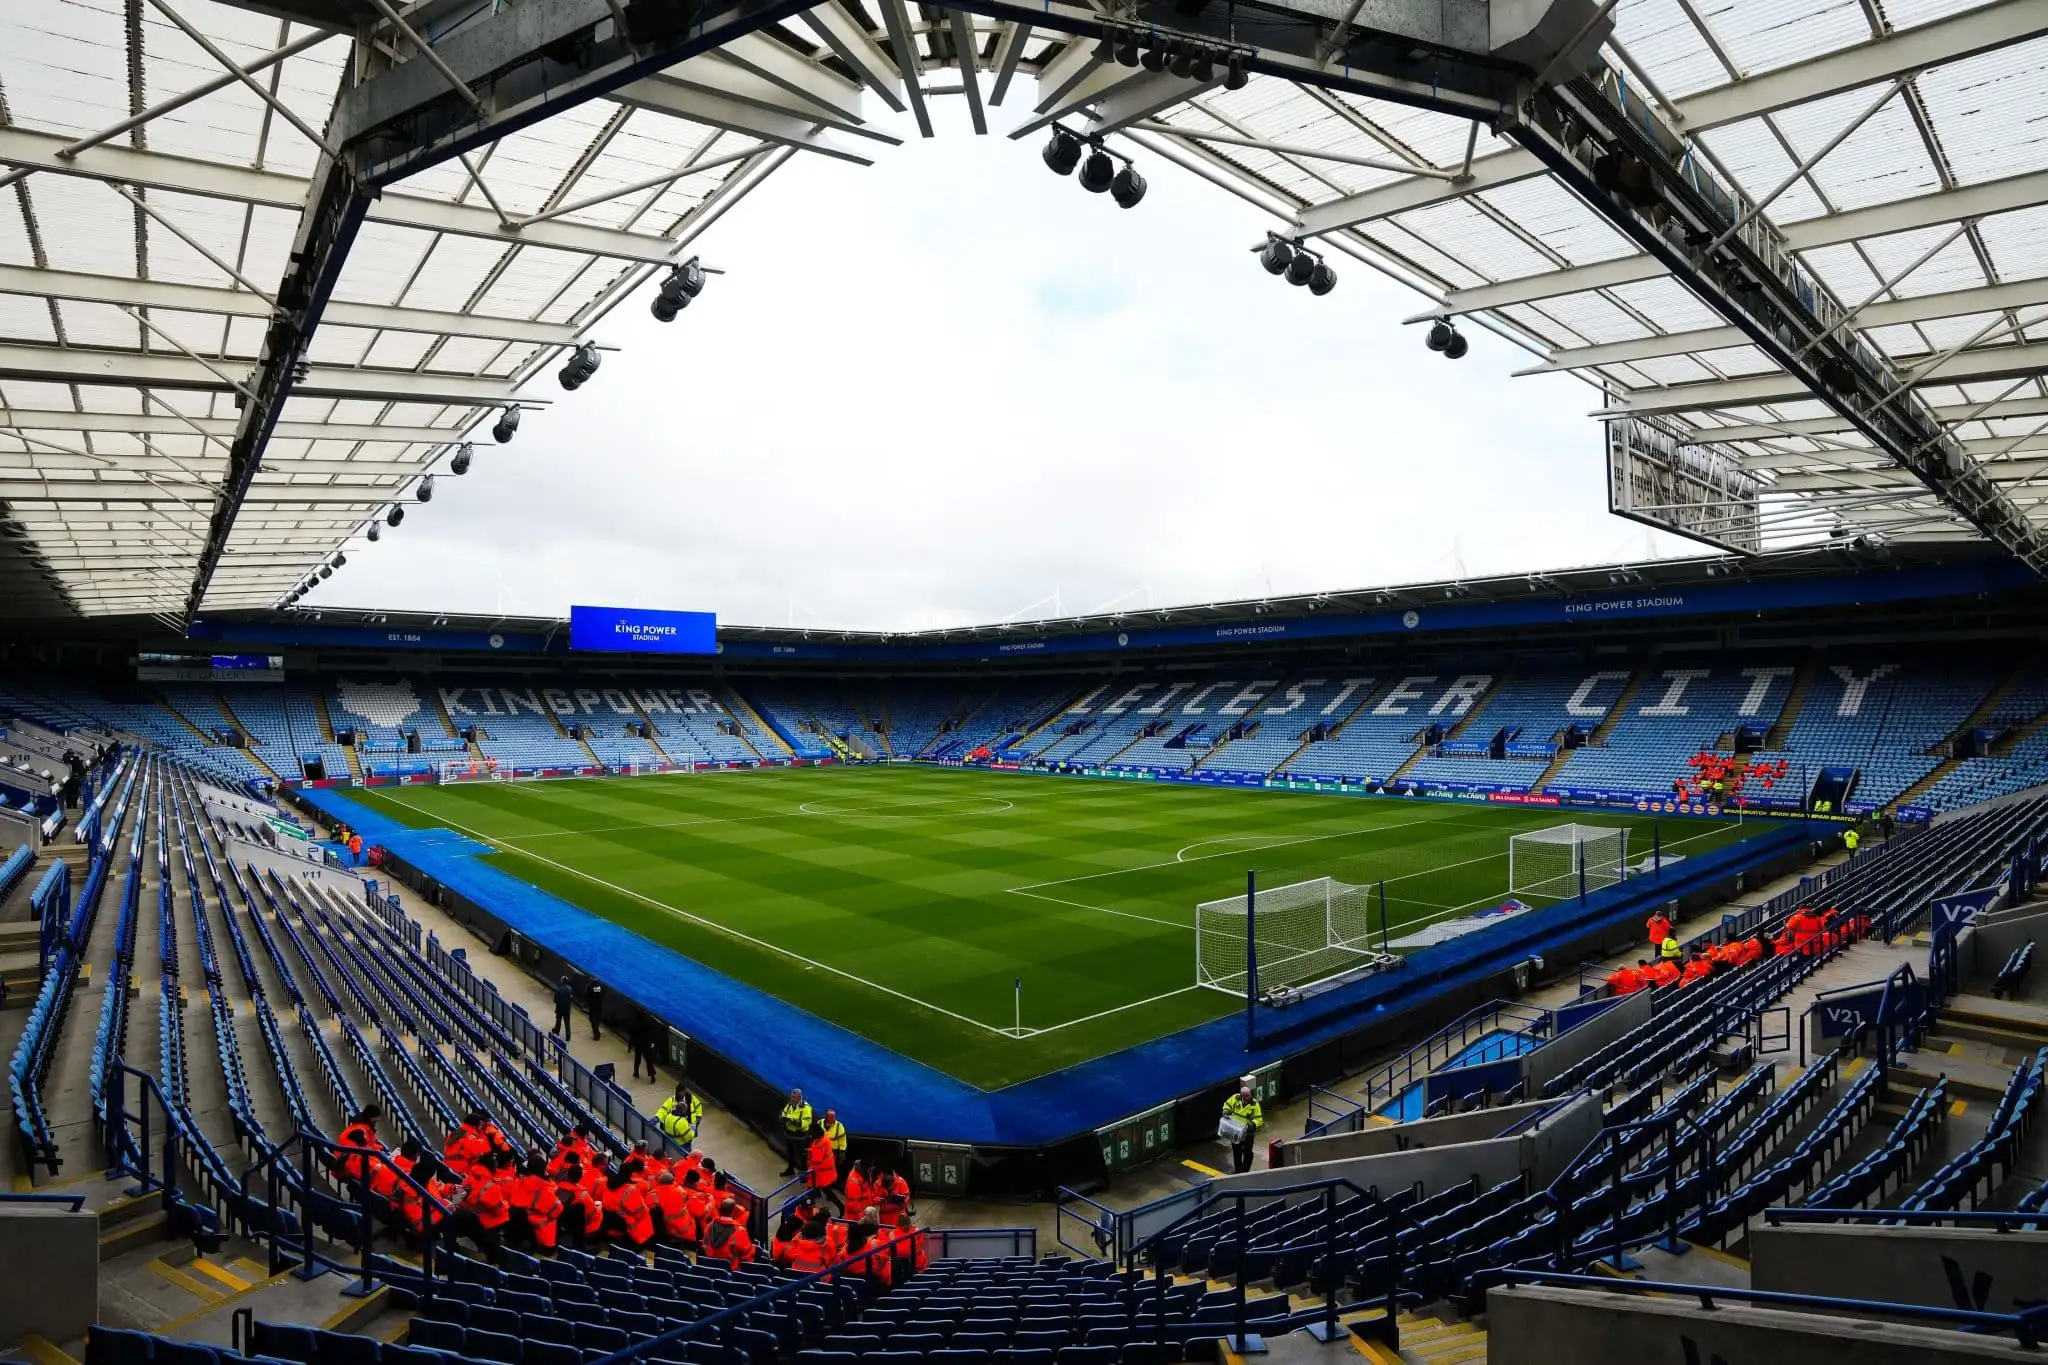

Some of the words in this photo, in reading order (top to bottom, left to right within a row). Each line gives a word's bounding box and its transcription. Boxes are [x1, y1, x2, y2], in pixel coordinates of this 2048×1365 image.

[1565, 603, 1592, 613] KING
[1595, 601, 1633, 611] POWER
[1636, 597, 1683, 608] STADIUM
[615, 624, 640, 634] KING
[643, 626, 676, 635] POWER
[1216, 629, 1232, 637] KING
[1233, 627, 1256, 635] POWER
[1257, 625, 1285, 633] STADIUM
[176, 671, 193, 680] THE
[199, 671, 246, 681] GALLERY
[1068, 675, 1497, 716] LEICESTER
[1565, 664, 1900, 716] CITY
[302, 780, 312, 789] 12
[350, 778, 363, 787] 12
[399, 776, 411, 785] 12
[1941, 903, 1985, 925] V2
[1827, 1007, 1861, 1024] V21
